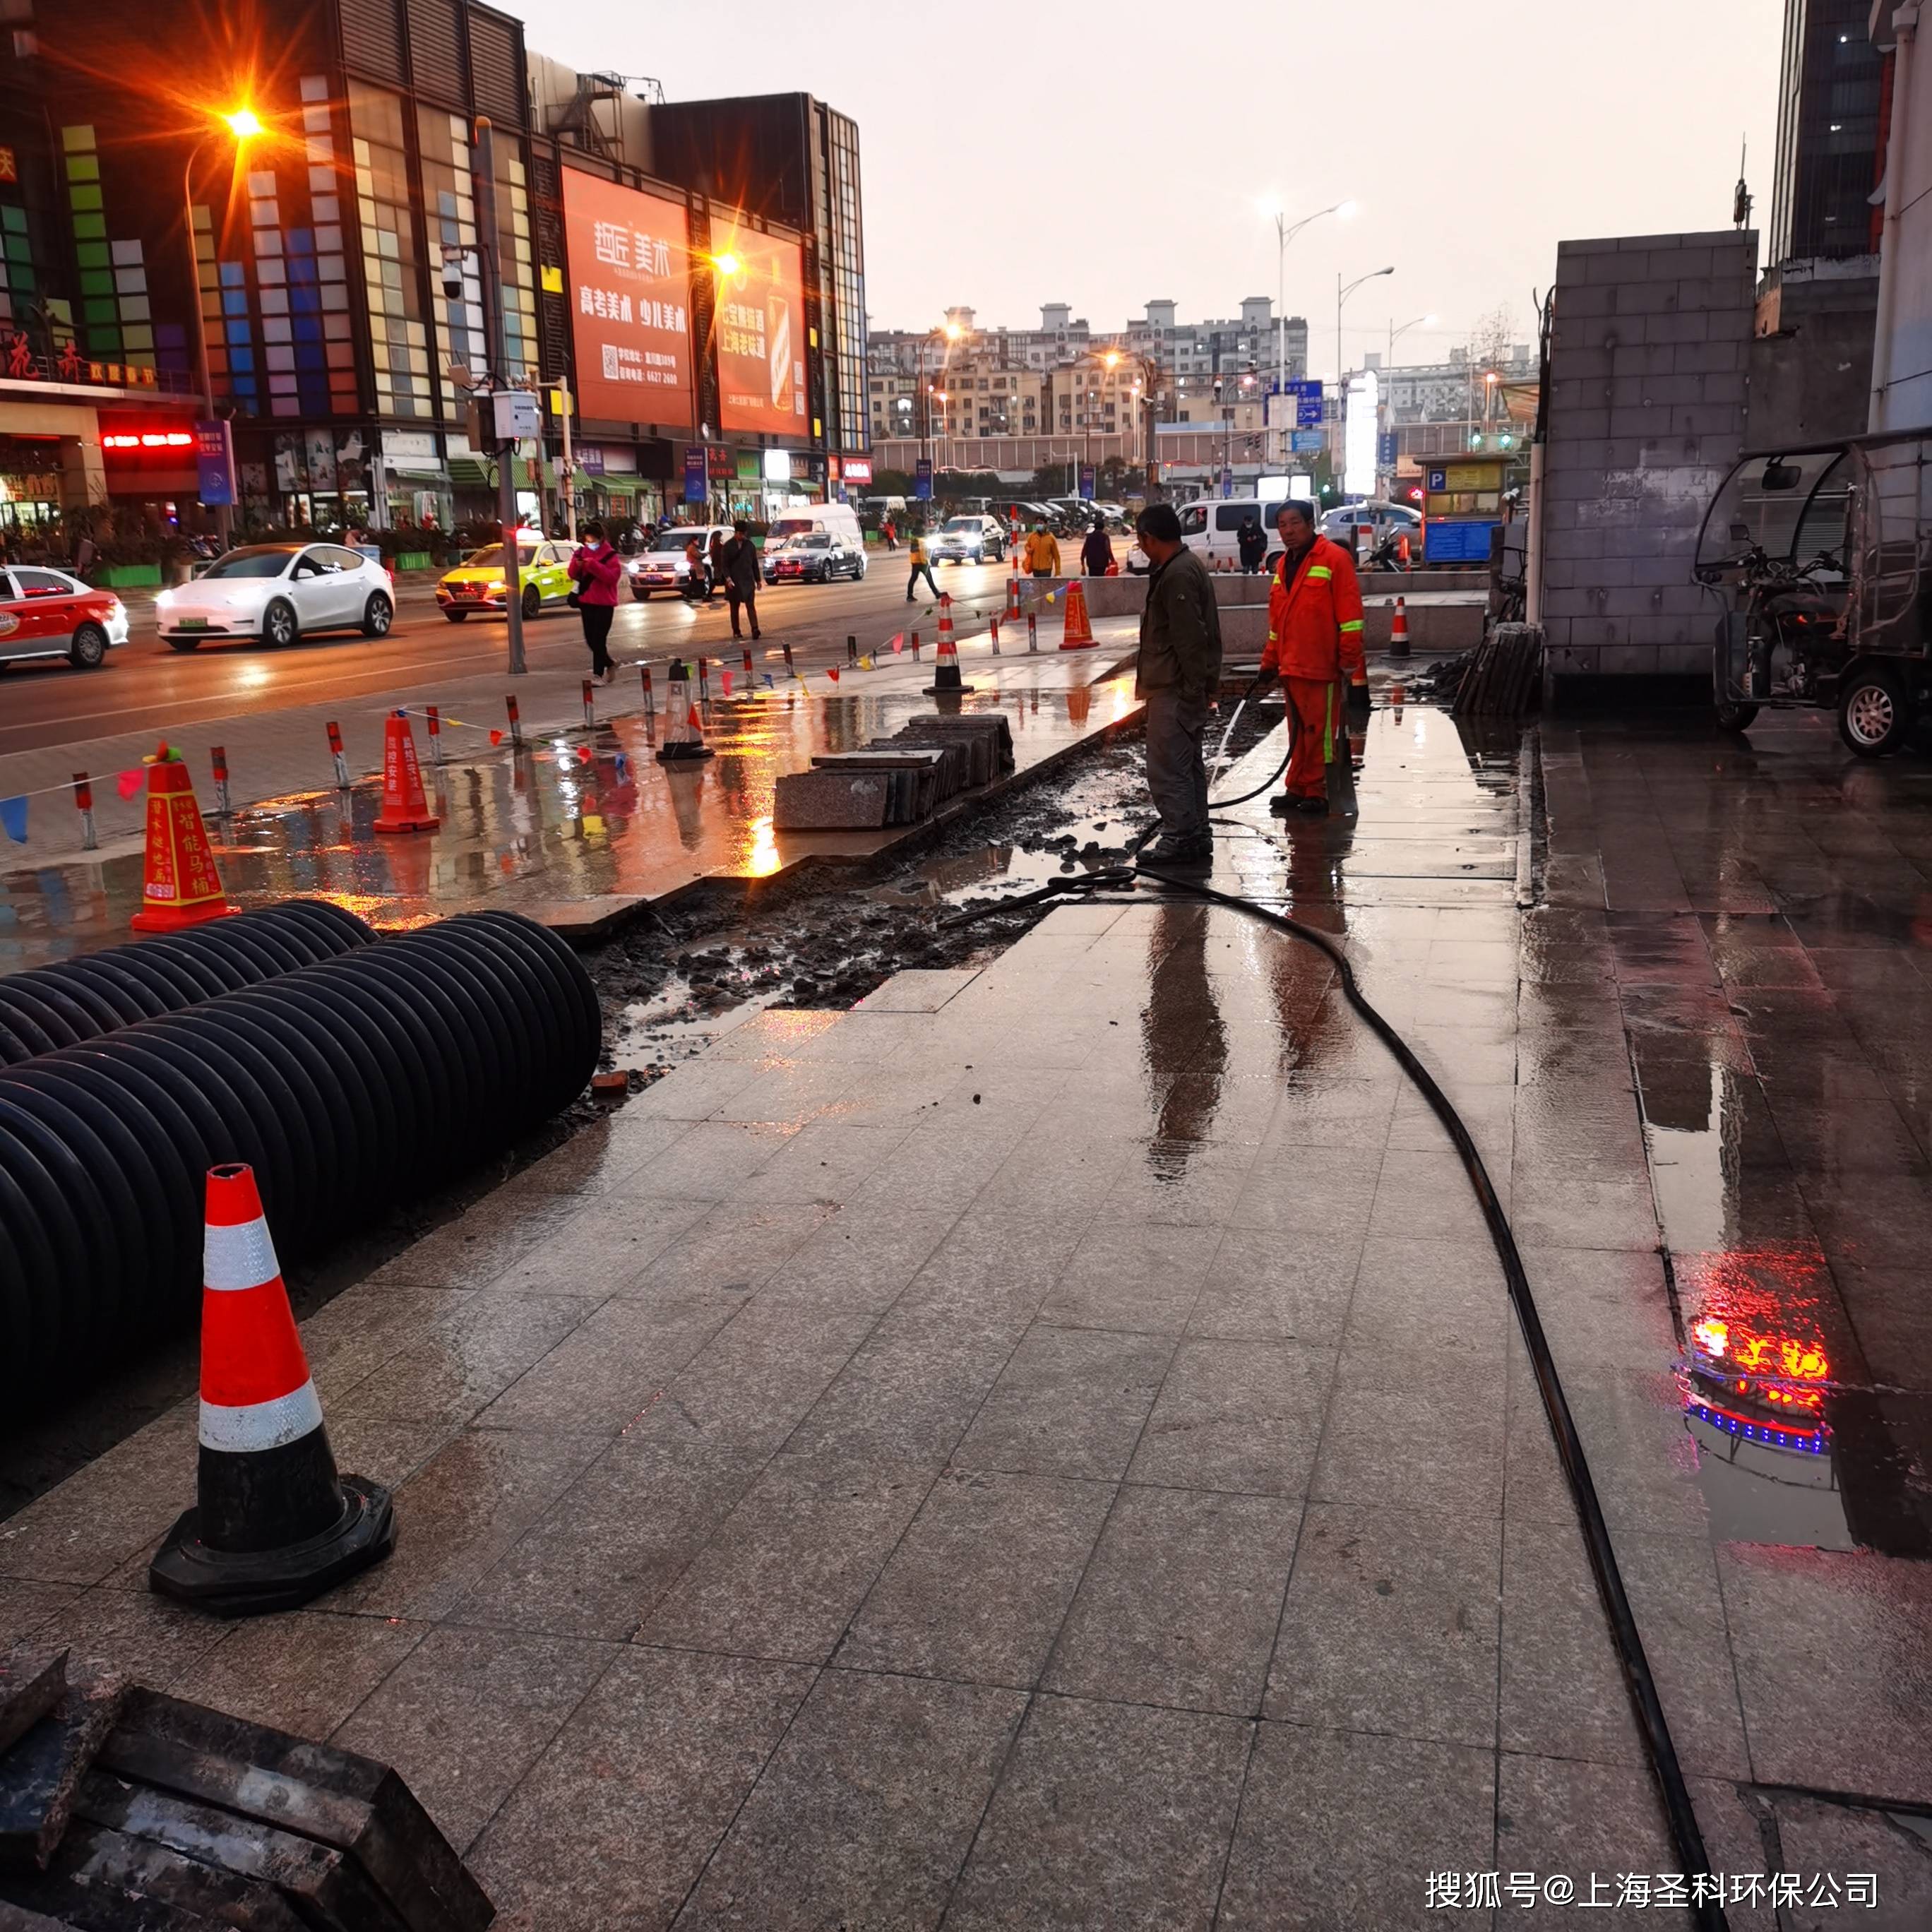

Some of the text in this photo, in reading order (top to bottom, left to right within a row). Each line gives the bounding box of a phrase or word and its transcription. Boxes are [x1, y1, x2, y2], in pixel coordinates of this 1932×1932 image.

[580, 285, 686, 333] 高考美术 少儿美术
[722, 328, 766, 359] 上海老味道
[1432, 474, 1443, 487] P
[178, 813, 210, 895] 智能马桶
